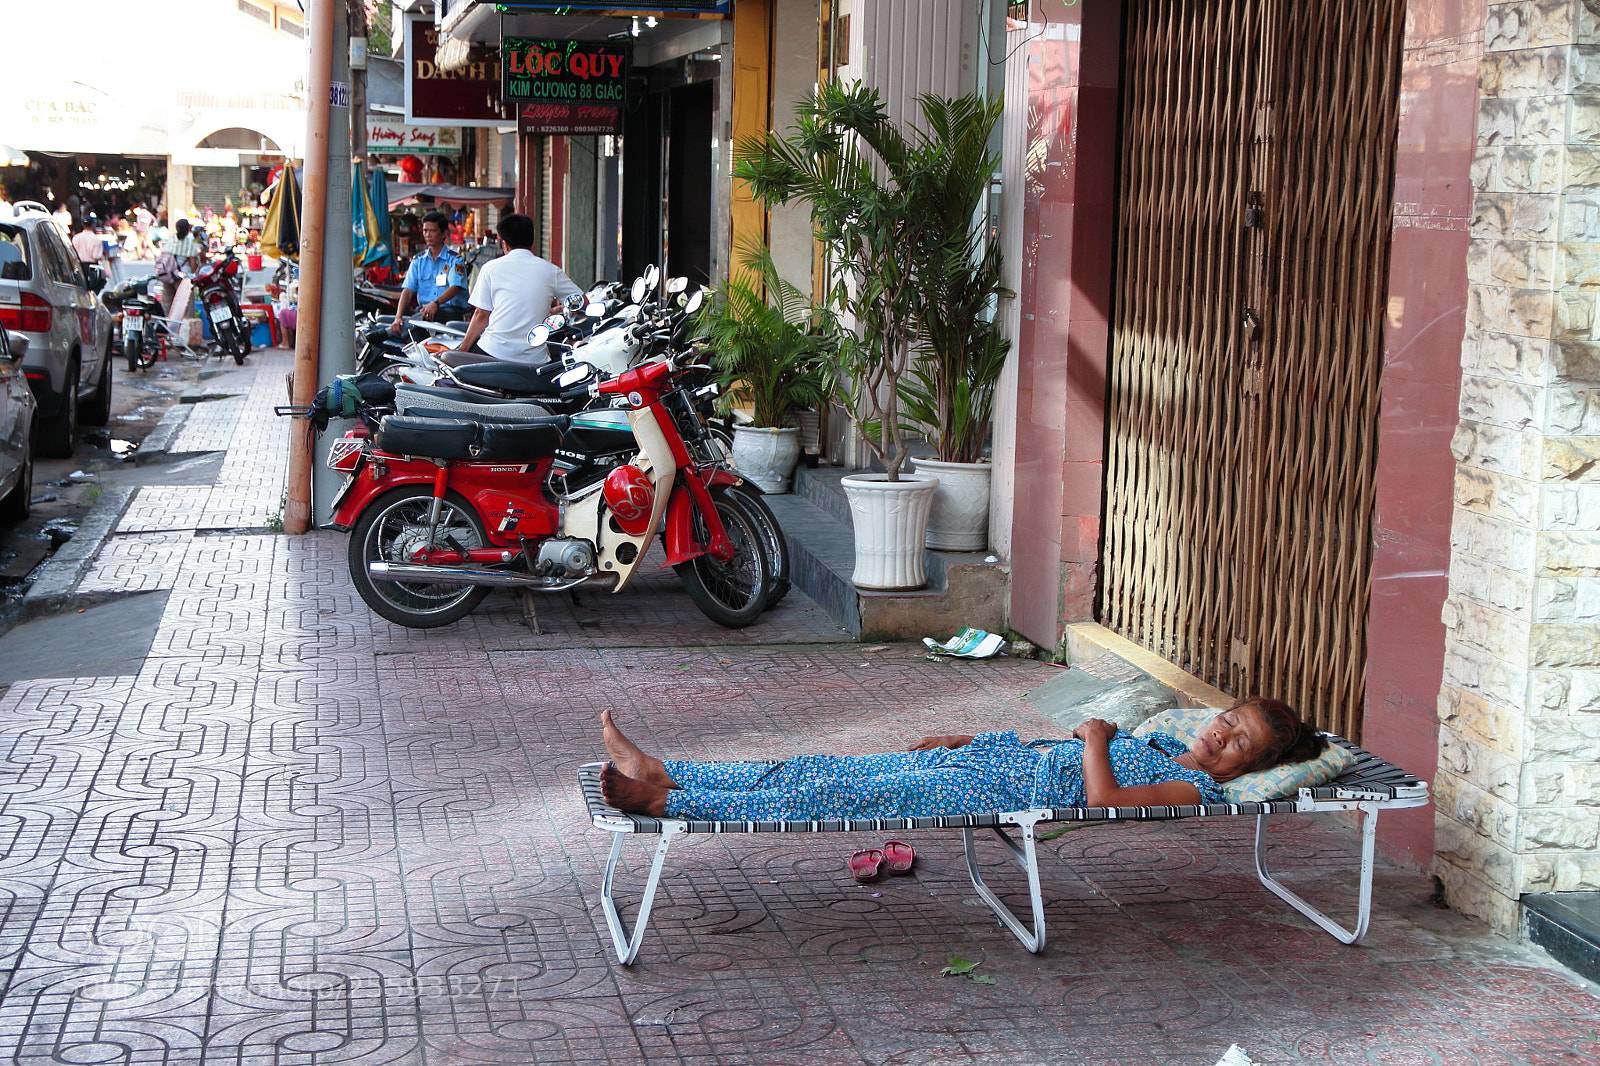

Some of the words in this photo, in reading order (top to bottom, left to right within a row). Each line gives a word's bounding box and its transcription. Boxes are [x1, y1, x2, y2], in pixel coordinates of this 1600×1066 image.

[509, 45, 561, 78] LỘC
[510, 80, 530, 96] KIM
[533, 81, 577, 98] CƯƠNG
[580, 84, 592, 99] 88
[595, 81, 622, 100] GIÁC
[410, 128, 436, 147] Sang
